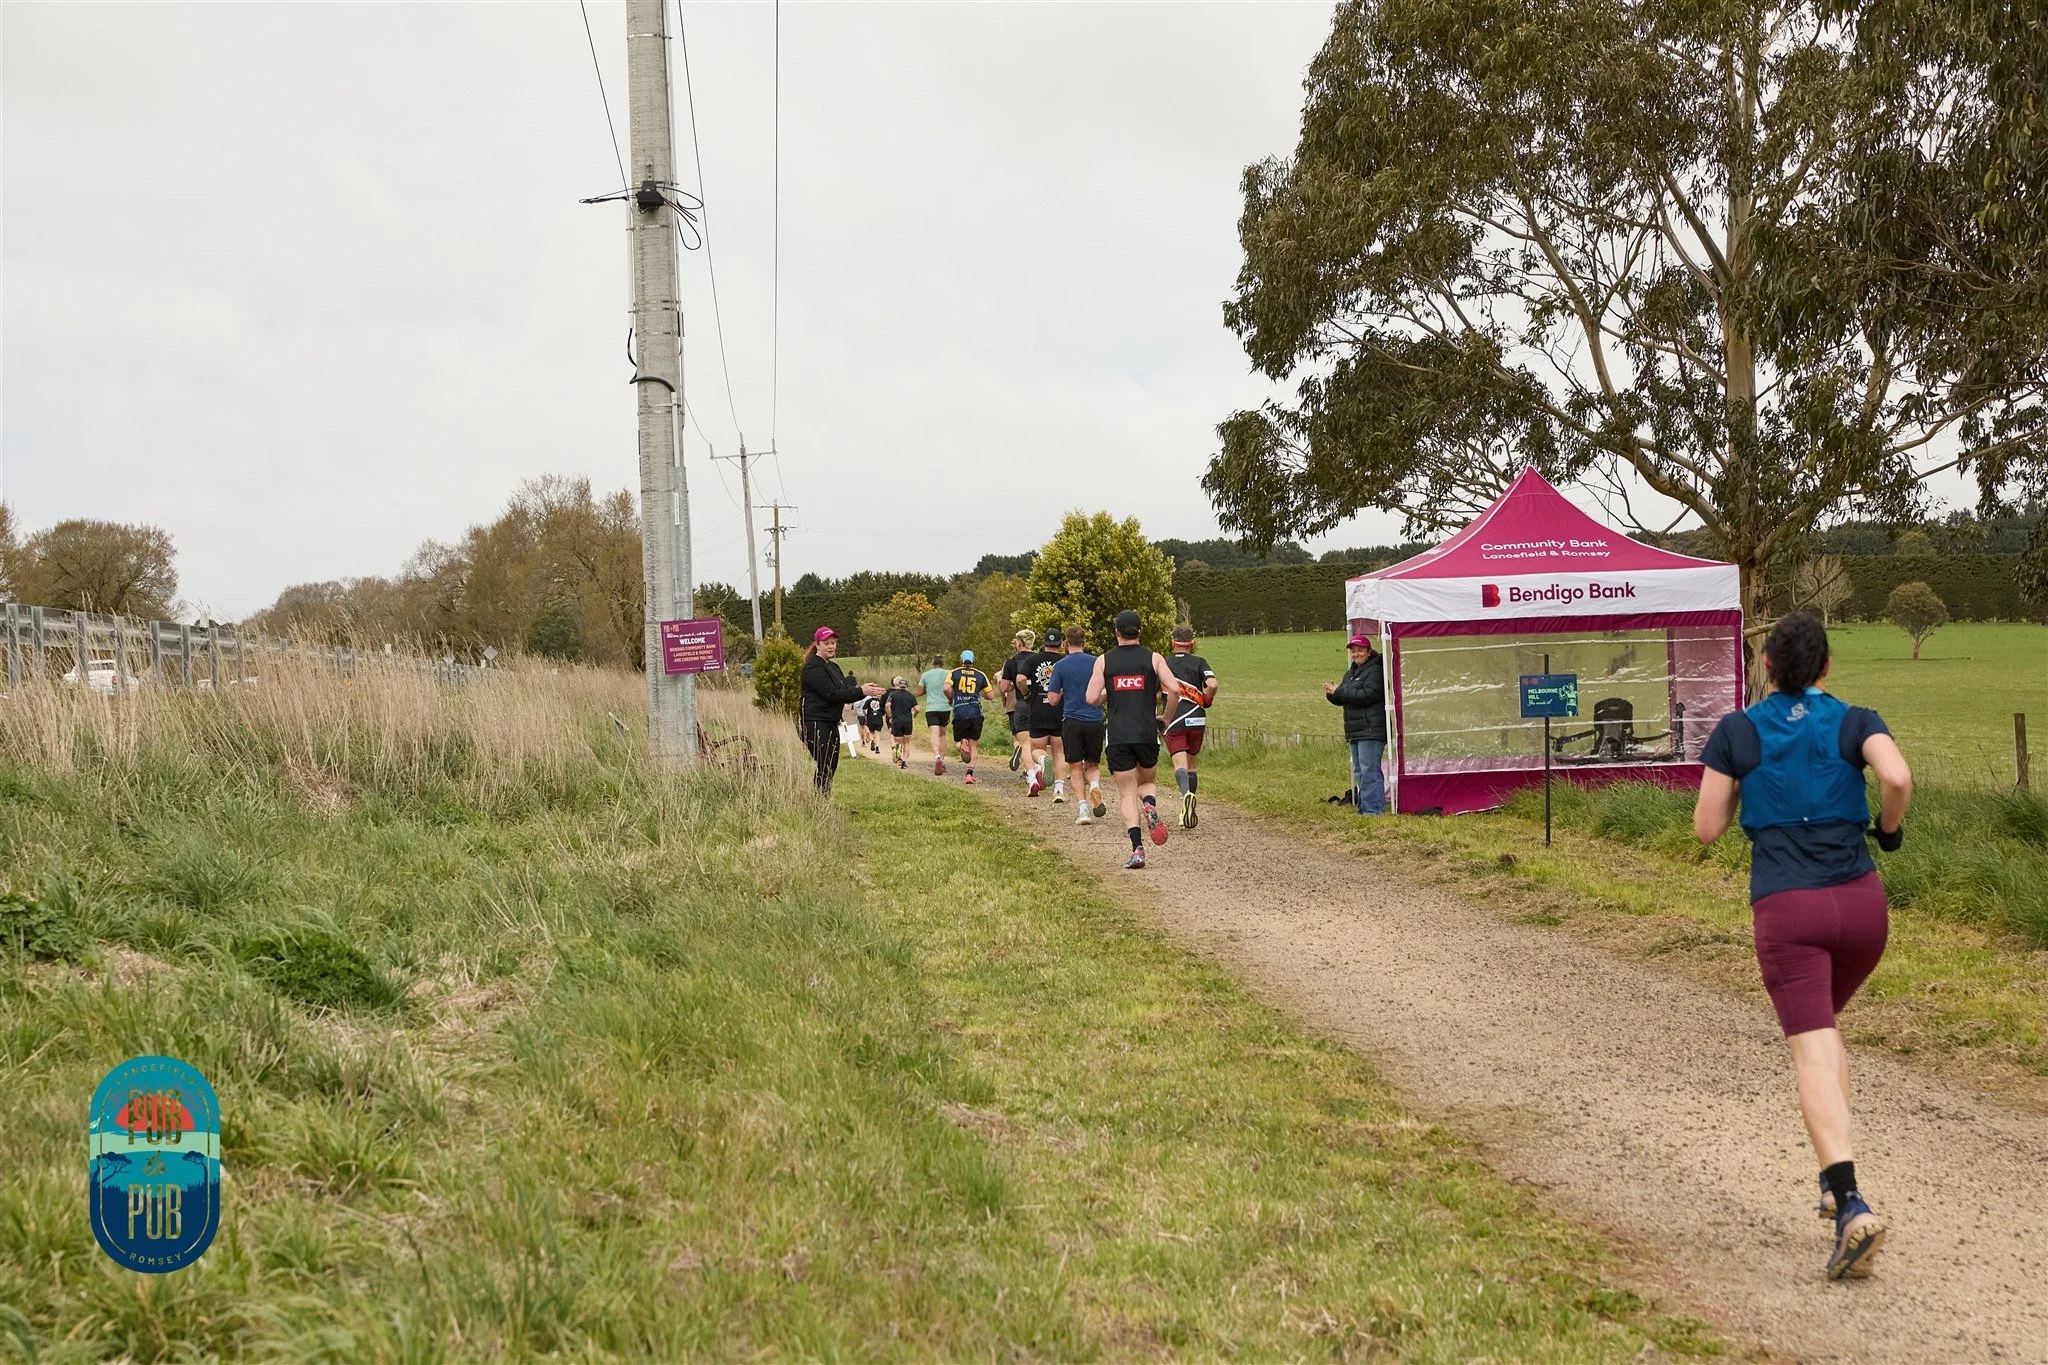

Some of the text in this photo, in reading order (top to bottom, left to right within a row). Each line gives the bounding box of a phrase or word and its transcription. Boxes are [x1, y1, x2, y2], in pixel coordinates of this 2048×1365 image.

[1481, 539, 1608, 551] Community Bank
[1482, 551, 1547, 560] Lancefield
[1562, 550, 1611, 558] Romsey
[1509, 582, 1636, 605] Bendigo Bank
[679, 637, 706, 645] WELCOME
[959, 676, 977, 694] 45
[1117, 677, 1142, 688] KFC
